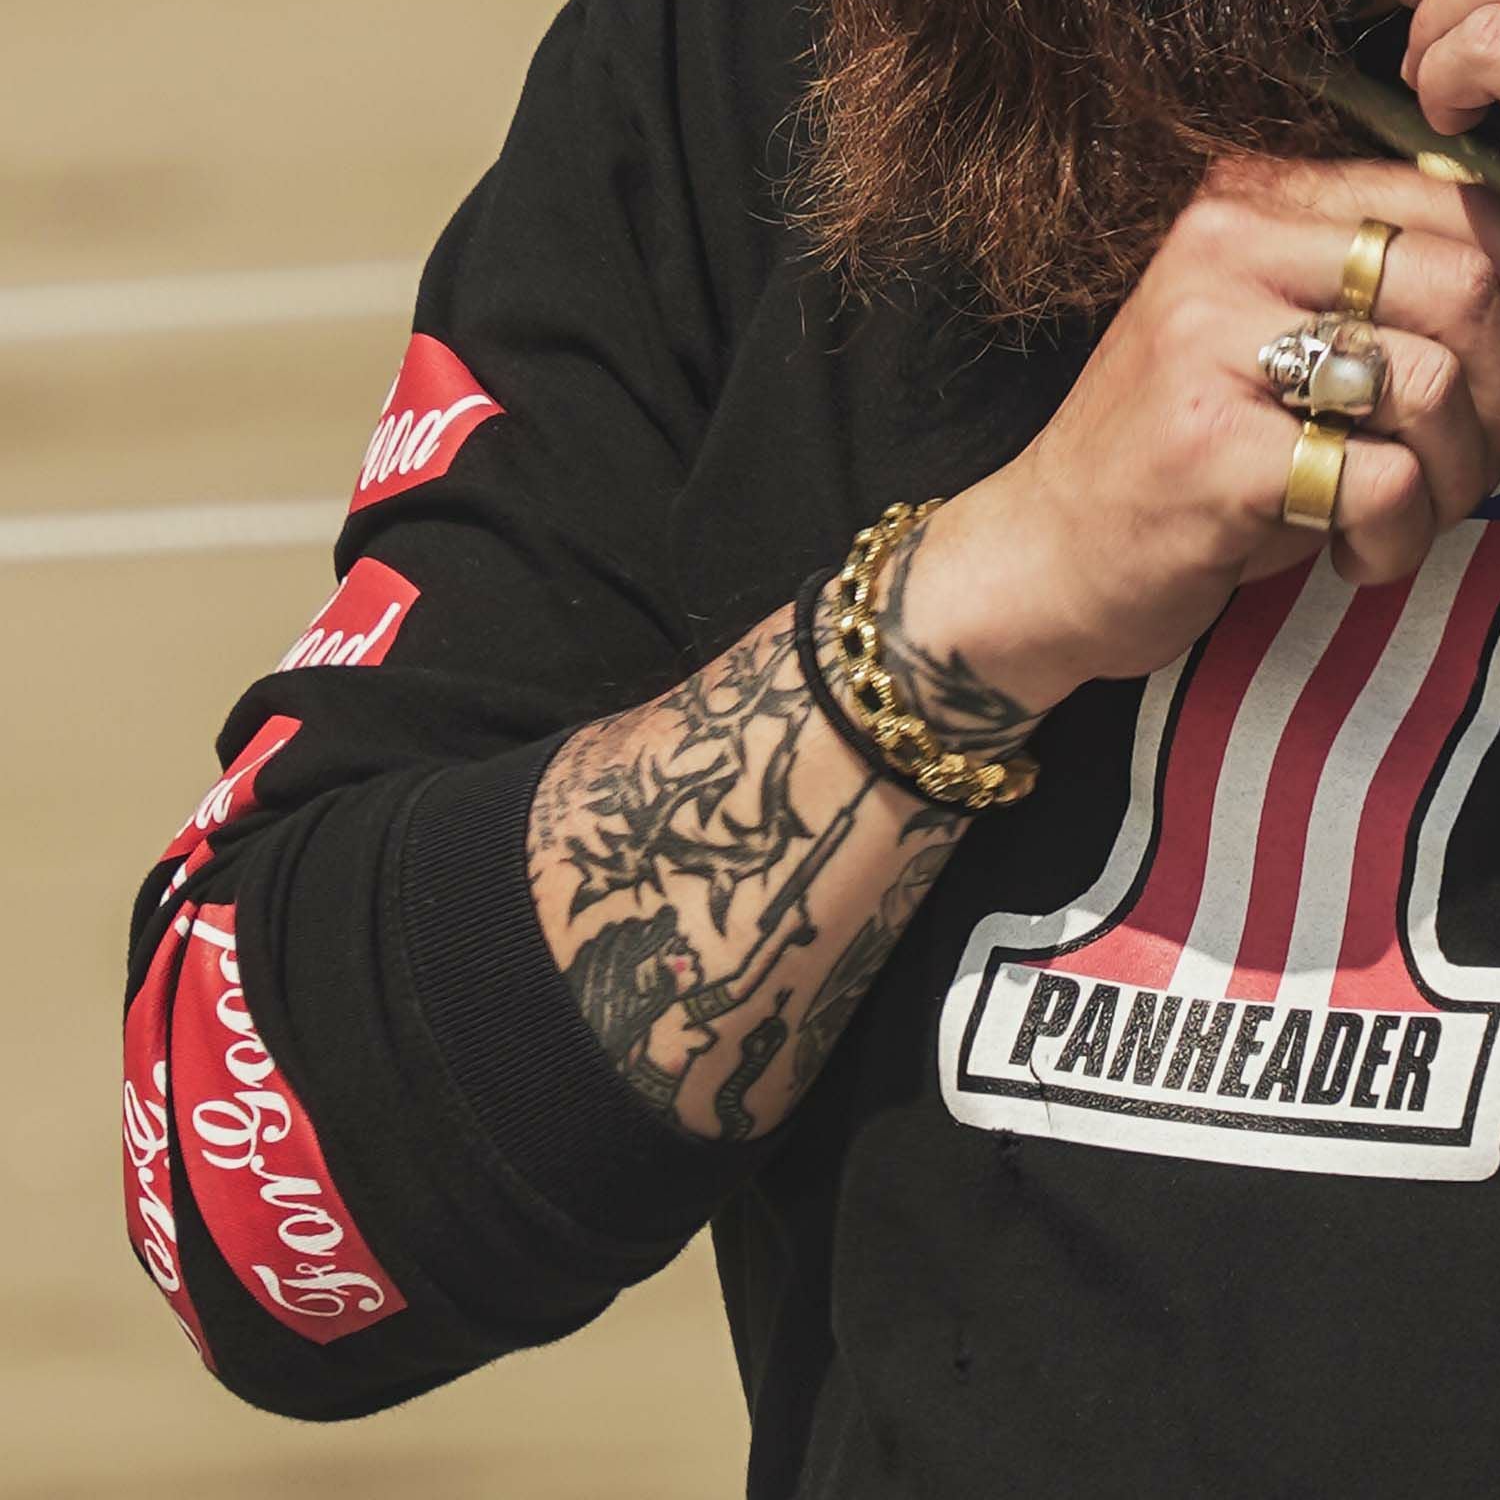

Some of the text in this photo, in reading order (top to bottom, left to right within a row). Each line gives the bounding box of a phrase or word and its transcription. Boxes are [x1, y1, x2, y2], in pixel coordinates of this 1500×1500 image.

[360, 365, 494, 491] ood
[1008, 971, 1443, 1111] PANHEADER
[249, 1155, 385, 1318] For
